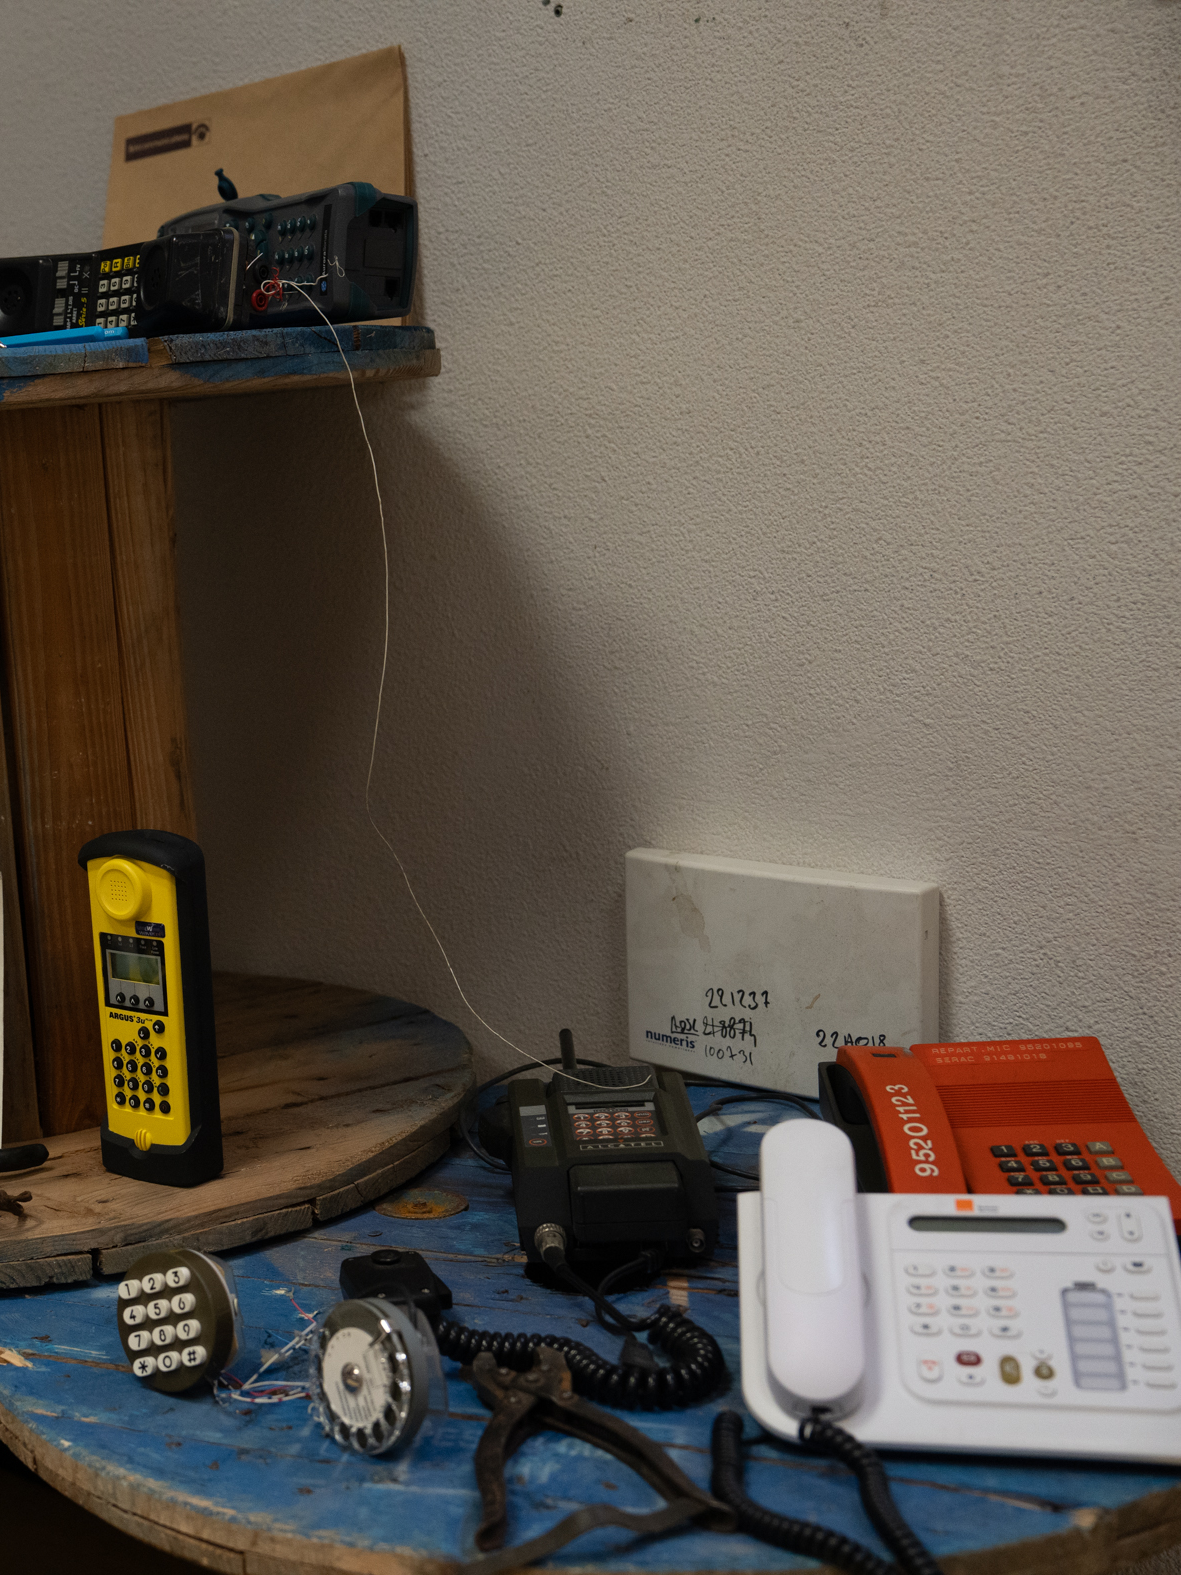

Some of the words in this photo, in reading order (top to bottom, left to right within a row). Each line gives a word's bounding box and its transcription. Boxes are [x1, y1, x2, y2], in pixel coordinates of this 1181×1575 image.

[109, 1011, 135, 1023] ARGUS
[645, 1030, 696, 1049] numeris
[935, 1056, 975, 1064] SERAC
[885, 1084, 940, 1177] 95201123
[586, 1142, 656, 1150] ALCATEL
[1030, 1144, 1043, 1152] 2
[124, 1283, 131, 1296] 1
[148, 1277, 156, 1290] 2
[172, 1270, 180, 1284] 3
[129, 1309, 136, 1322] 4
[153, 1302, 161, 1316] 5
[178, 1297, 186, 1310] 6
[134, 1334, 141, 1348] 7
[159, 1329, 166, 1342] 8
[182, 1323, 190, 1337] 9
[162, 1355, 172, 1368] 0
[187, 1349, 196, 1363] #
